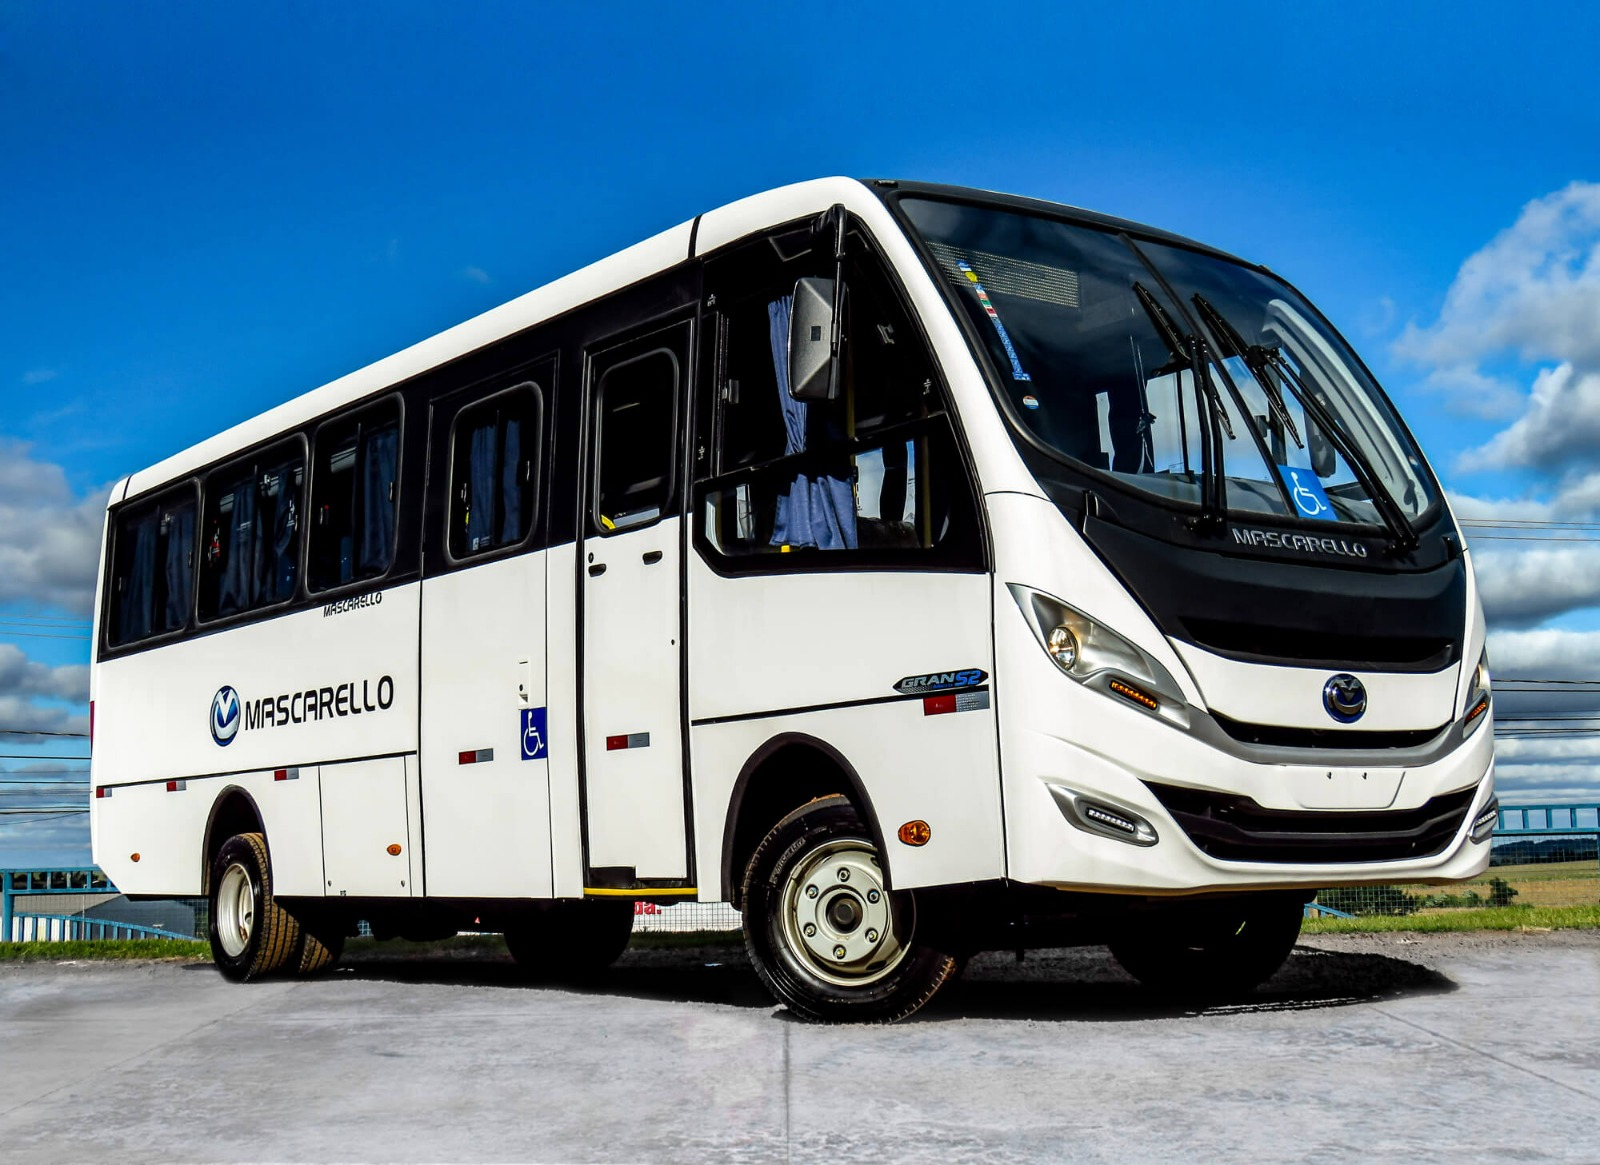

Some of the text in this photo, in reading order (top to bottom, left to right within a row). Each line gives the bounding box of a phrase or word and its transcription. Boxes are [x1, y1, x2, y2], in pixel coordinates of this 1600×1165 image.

[1231, 527, 1368, 558] MASCARELLO
[323, 592, 383, 618] MASCARELLO
[244, 675, 395, 731] MASCARELLO
